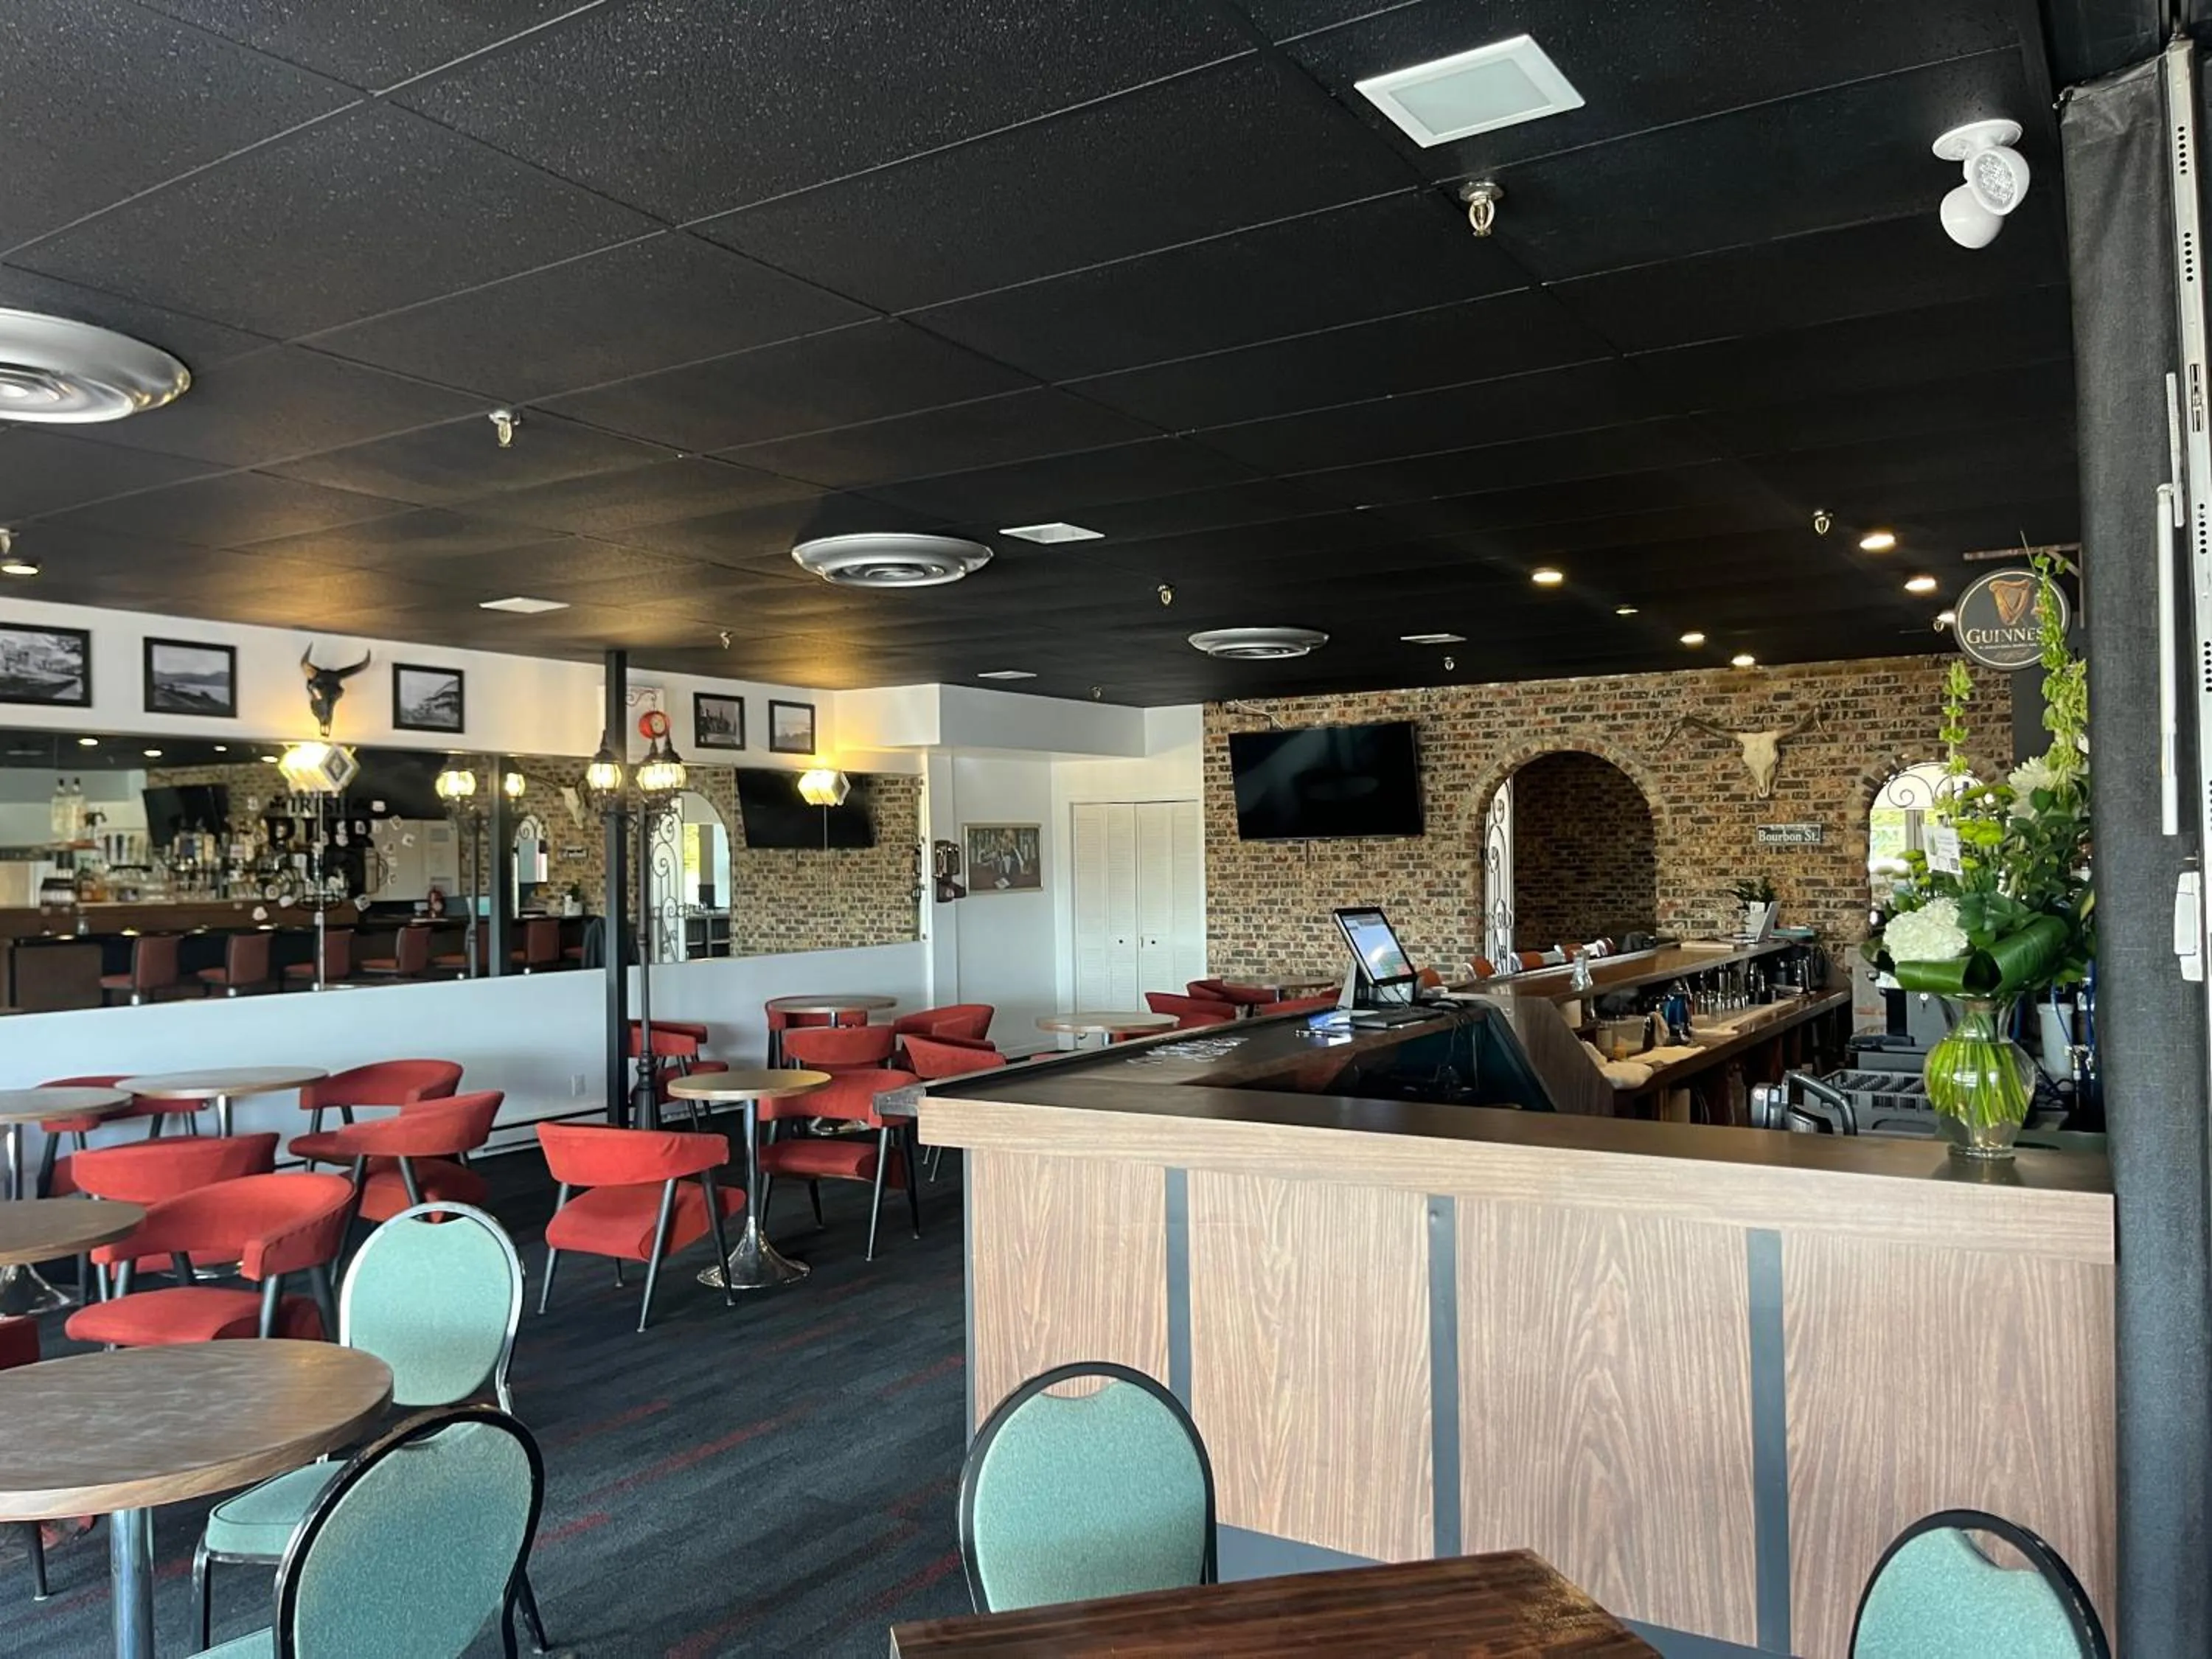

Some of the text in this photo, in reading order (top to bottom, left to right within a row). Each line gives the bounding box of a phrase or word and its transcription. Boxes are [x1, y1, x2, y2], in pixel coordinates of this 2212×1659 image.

[1966, 627, 2044, 644] GUINNES
[1759, 830, 1820, 841] Bourbon St.
